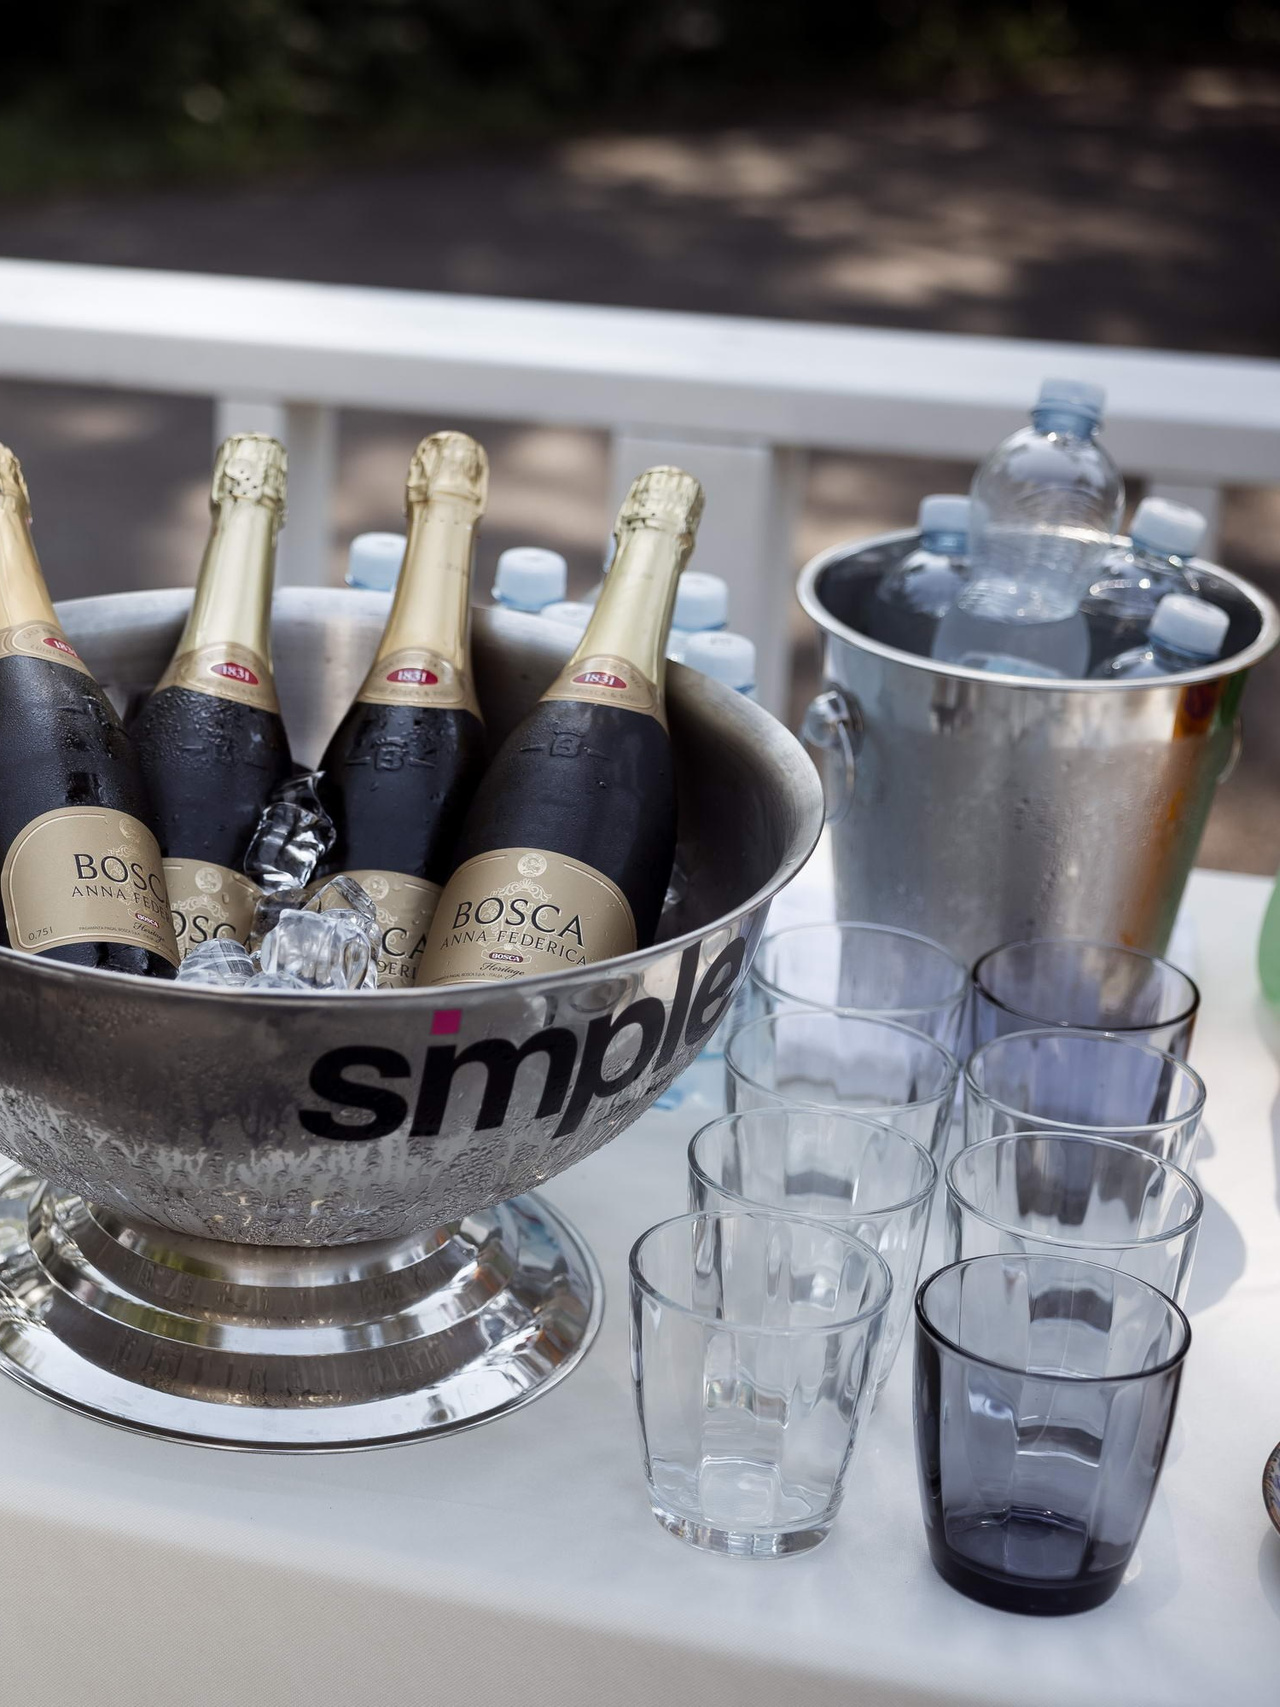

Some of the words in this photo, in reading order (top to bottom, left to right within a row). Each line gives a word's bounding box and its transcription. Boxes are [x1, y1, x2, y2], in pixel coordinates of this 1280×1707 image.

[222, 664, 250, 681] 1831
[397, 669, 427, 682] 1831
[584, 673, 615, 686] 1831
[73, 853, 170, 909] BOSC
[72, 885, 127, 901] ANNA
[452, 897, 585, 948] BOSCA
[440, 930, 487, 950] ANNA
[497, 930, 587, 966] FEDERICA
[491, 952, 521, 963] BOSCA
[479, 962, 525, 980] Heritage
[298, 934, 748, 1142] simple
